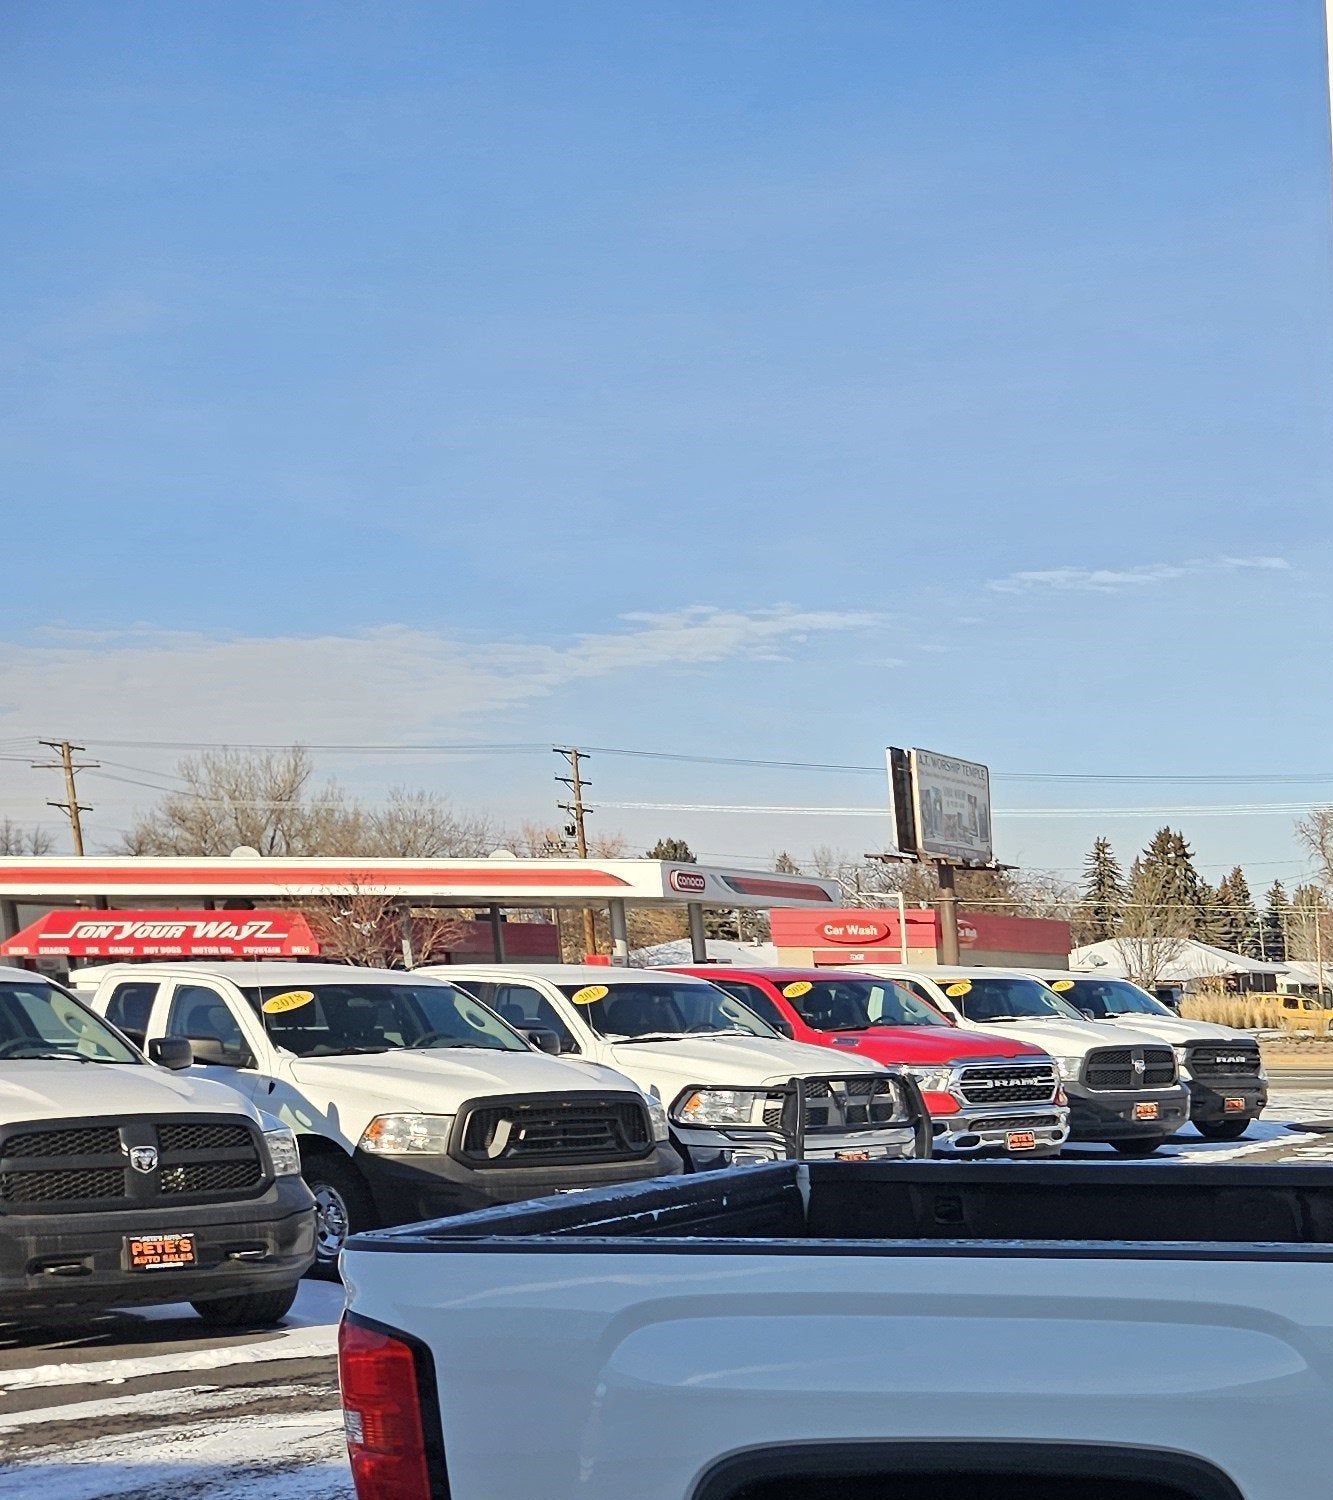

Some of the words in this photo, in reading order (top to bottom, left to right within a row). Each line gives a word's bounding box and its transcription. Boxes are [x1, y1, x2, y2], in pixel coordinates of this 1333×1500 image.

[962, 764, 986, 781] TEMPLE
[824, 925, 844, 936] Car
[847, 925, 878, 936] Wash
[995, 1078, 1035, 1087] RAM
[131, 1239, 193, 1256] PETE'S
[133, 1255, 160, 1265] AUTO
[162, 1252, 194, 1262] SALES
